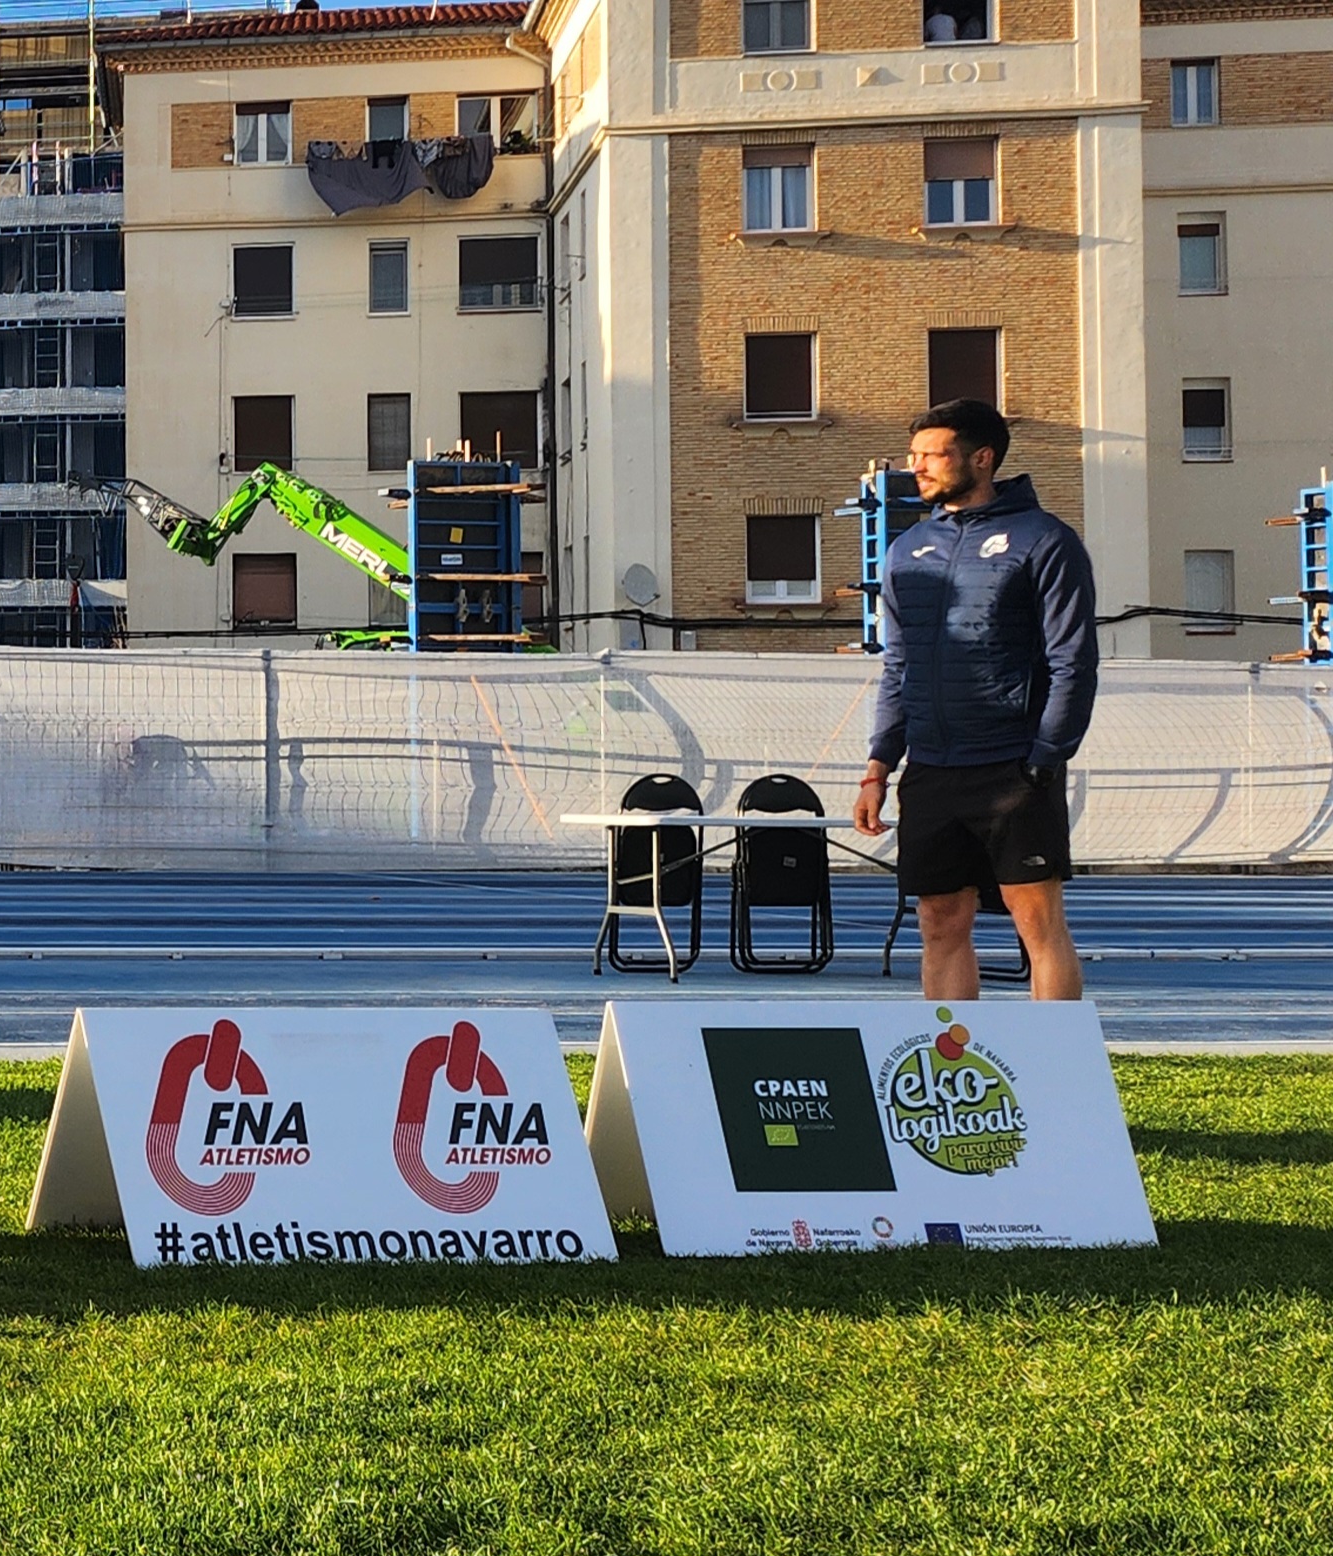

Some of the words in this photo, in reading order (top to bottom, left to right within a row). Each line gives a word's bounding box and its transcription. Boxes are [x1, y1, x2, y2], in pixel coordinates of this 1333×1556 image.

[973, 1042, 985, 1053] DE
[985, 1050, 1019, 1083] NAVARRA
[754, 1079, 828, 1097] CPAEN
[204, 1101, 310, 1145] FNA
[758, 1101, 834, 1120] NNPEK
[449, 1102, 549, 1145] FNA
[885, 1094, 1027, 1153] logikoak
[199, 1146, 311, 1167] ATLETISMO
[445, 1146, 552, 1166] ATLETISMO
[946, 1140, 988, 1165] para
[964, 1223, 996, 1234] UNIÓN
[998, 1224, 1043, 1234] EUROPEA
[155, 1222, 584, 1262] #atletismonavarro
